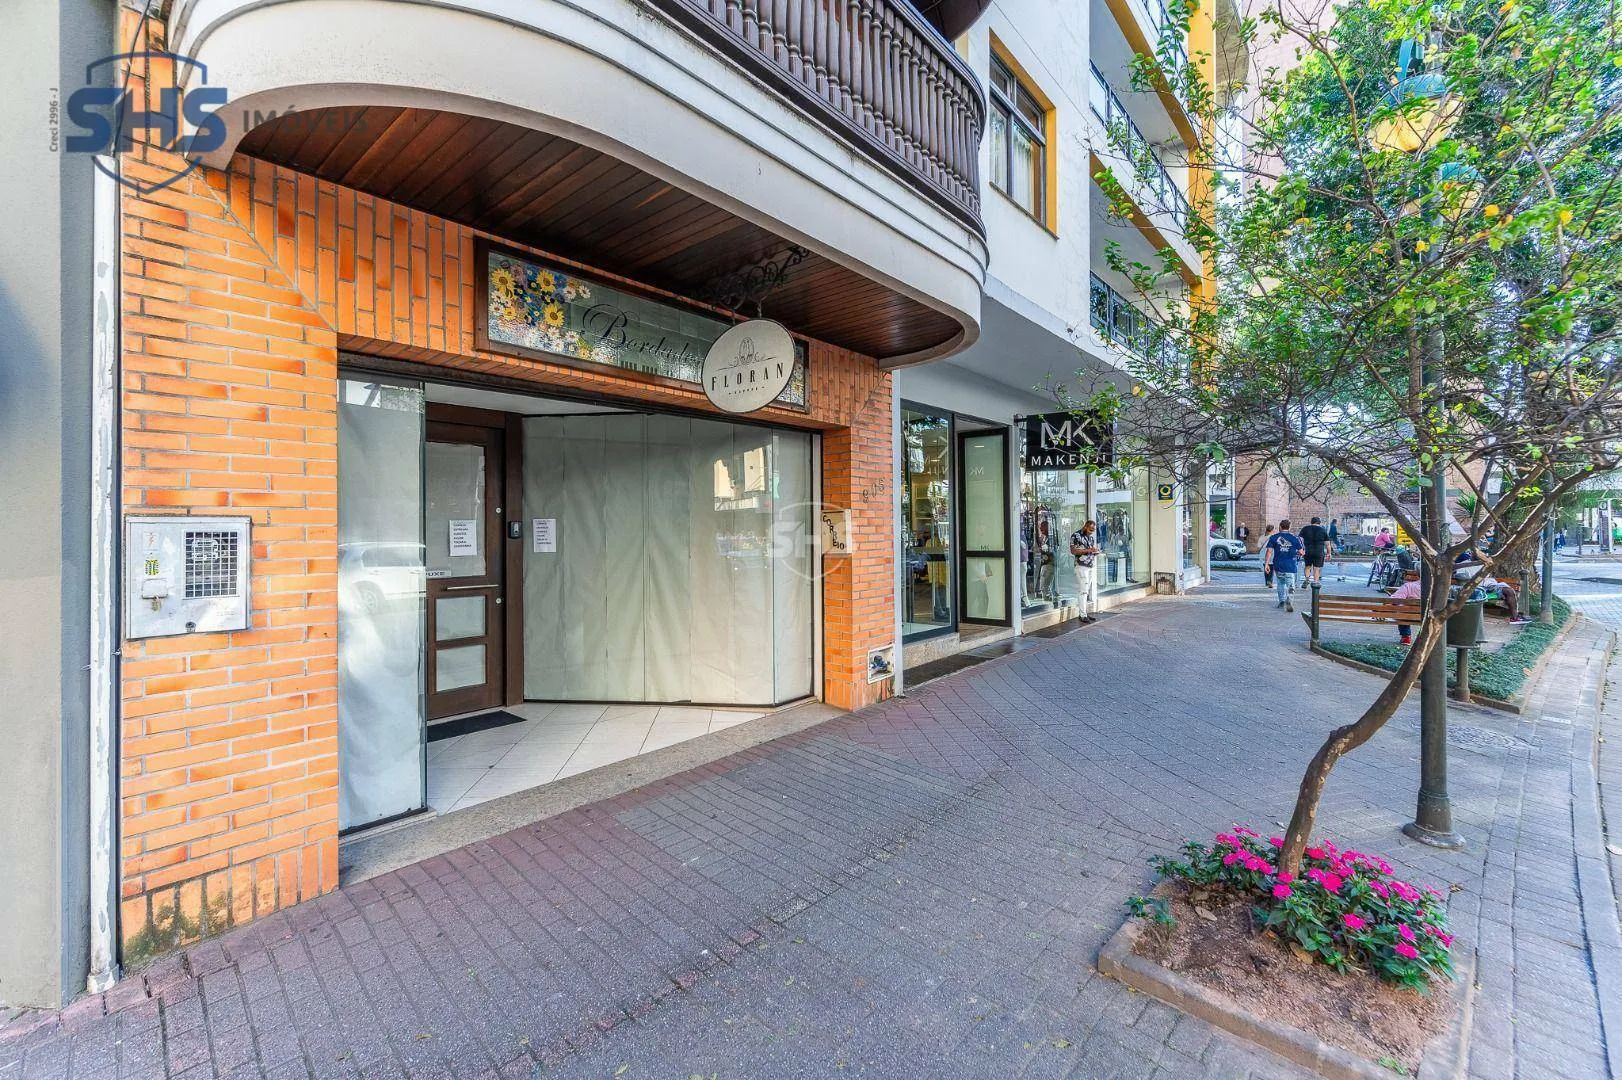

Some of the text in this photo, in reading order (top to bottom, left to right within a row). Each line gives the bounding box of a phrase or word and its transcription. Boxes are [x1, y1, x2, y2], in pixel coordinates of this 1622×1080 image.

[711, 362, 784, 391] FLORAN
[1040, 418, 1095, 449] MK
[822, 514, 846, 550] CORREIO
